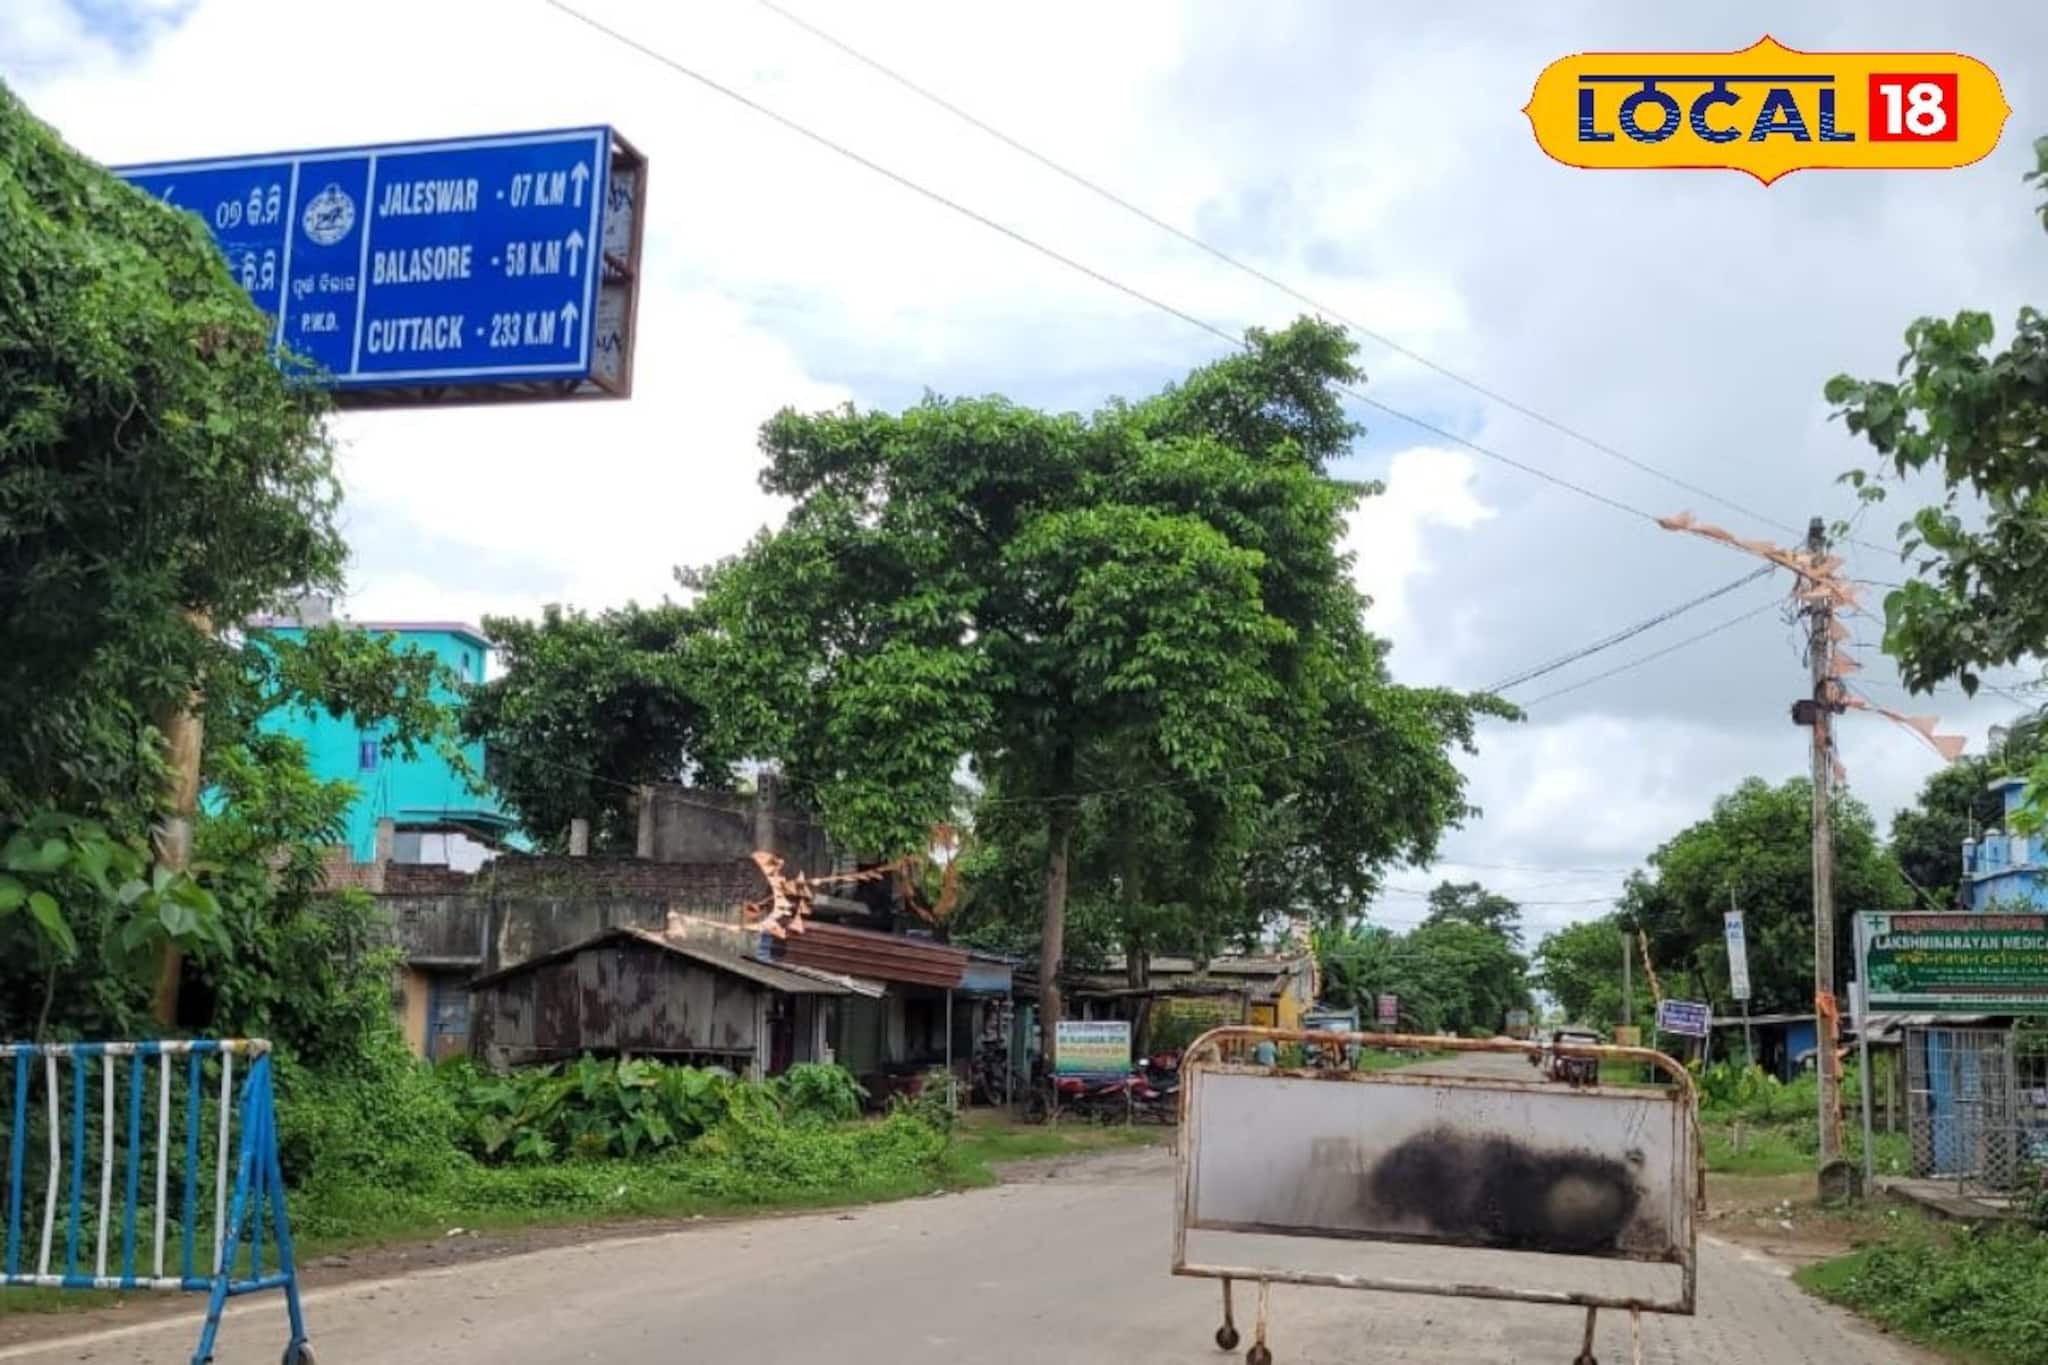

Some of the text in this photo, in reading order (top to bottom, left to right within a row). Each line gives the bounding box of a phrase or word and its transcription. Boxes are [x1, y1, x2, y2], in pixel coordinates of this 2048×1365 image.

[379, 178, 479, 217] JALESWAR
[510, 173, 532, 207] 07
[373, 245, 472, 285] BALASORE
[506, 242, 526, 277] 58
[367, 315, 464, 354] CUTTACK
[490, 313, 522, 347] 233
[1875, 935, 1999, 950] LAKSHMINARAYAN
